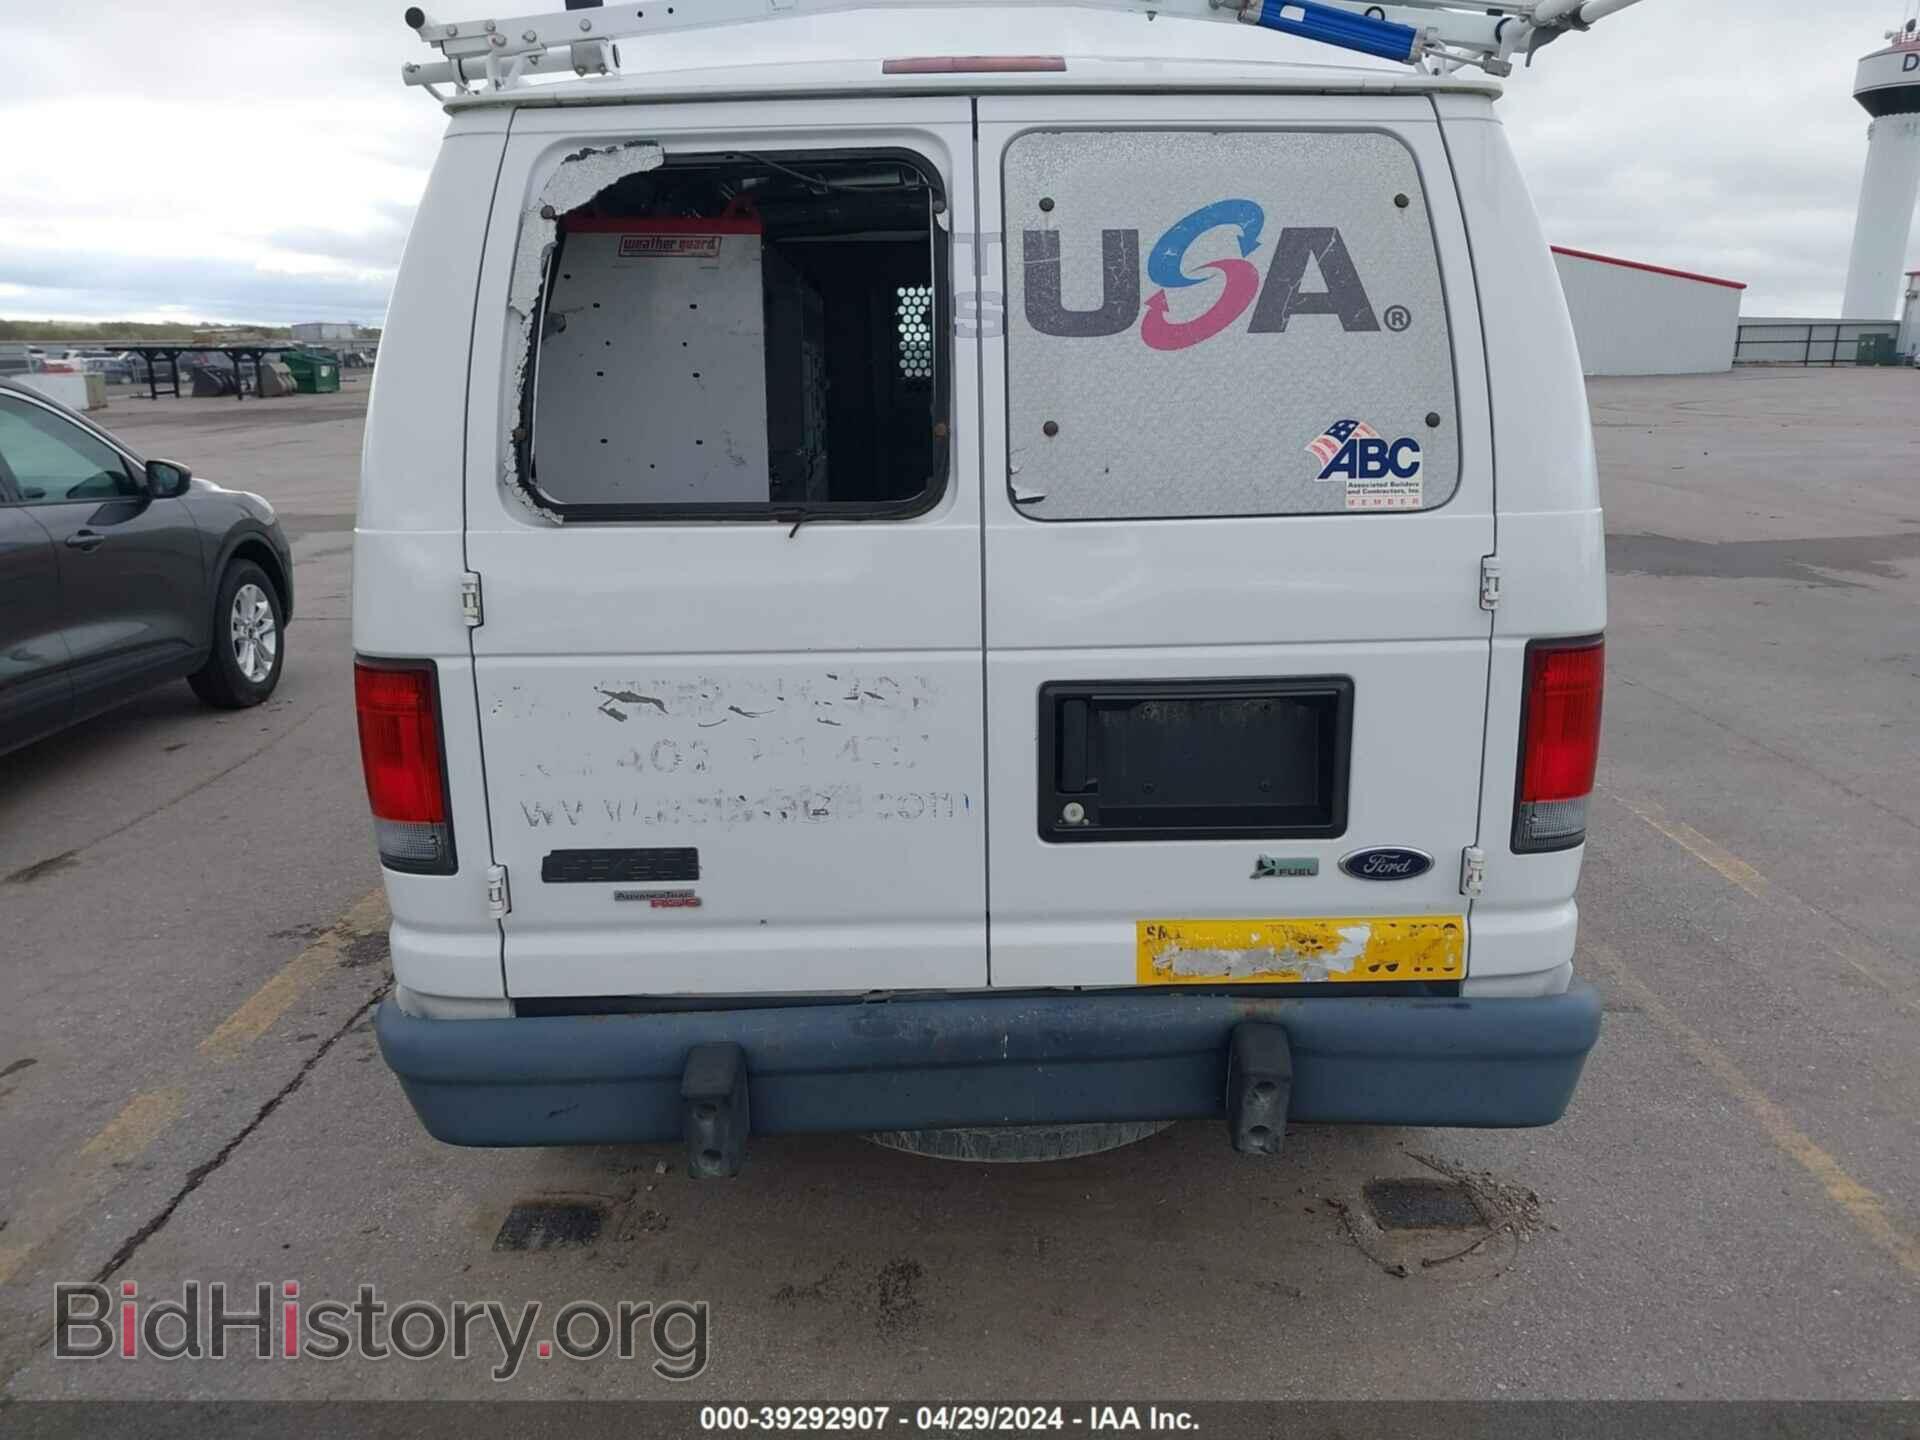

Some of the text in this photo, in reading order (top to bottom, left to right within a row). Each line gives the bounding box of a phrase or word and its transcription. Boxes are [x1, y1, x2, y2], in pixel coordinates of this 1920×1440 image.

[1317, 437, 1420, 479] ABC
[1279, 867, 1317, 877] FUEL
[1363, 854, 1411, 874] Ford
